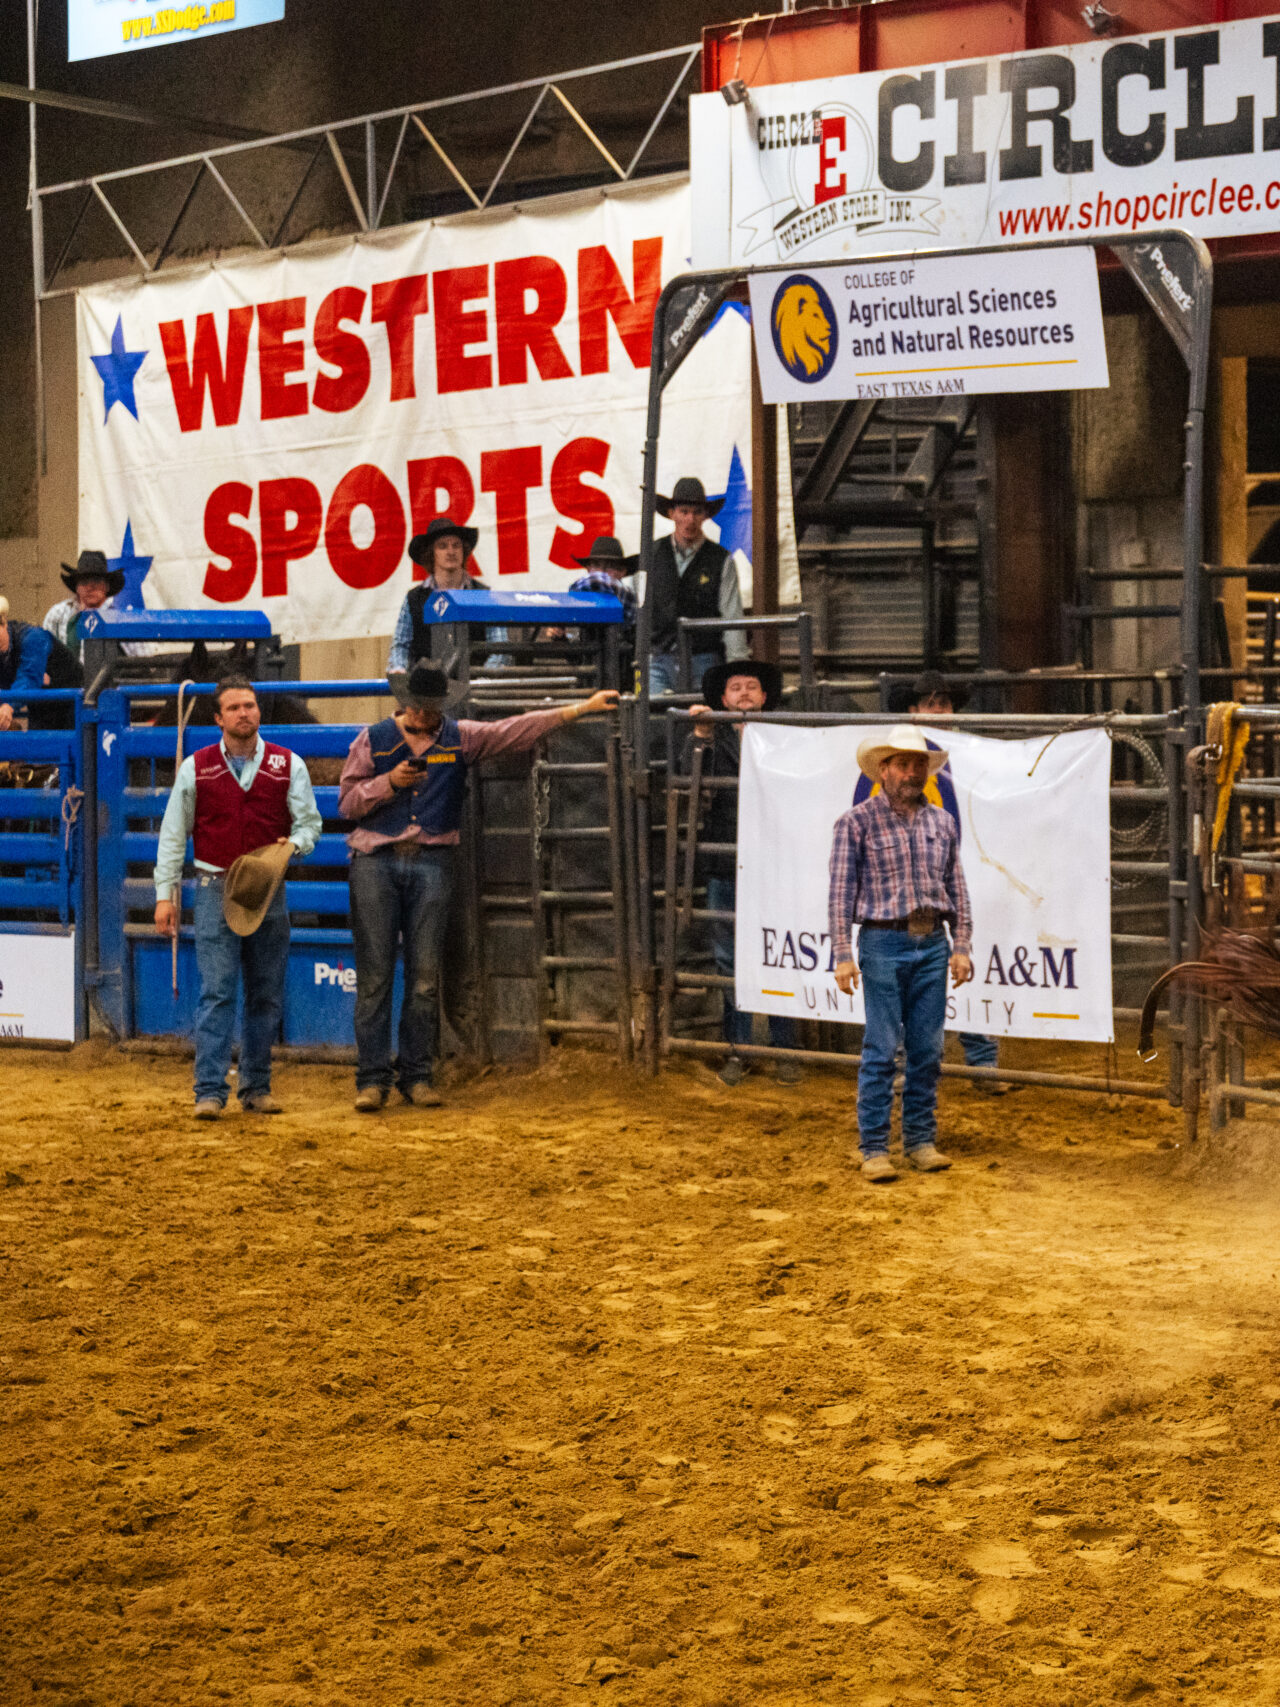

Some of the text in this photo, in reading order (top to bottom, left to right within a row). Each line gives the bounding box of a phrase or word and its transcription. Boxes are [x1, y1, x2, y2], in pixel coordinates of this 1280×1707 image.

[758, 110, 823, 150] CIRCLE
[779, 194, 915, 250] WESTERN STORE INC.
[844, 269, 915, 290] COLLEGE OF
[848, 289, 1057, 328] Agricultural Sciences
[158, 236, 664, 432] WESTERN
[852, 323, 1074, 357] and Natural Resources
[857, 378, 965, 399] EAST TEXAS A&M
[984, 943, 1079, 990] A&M
